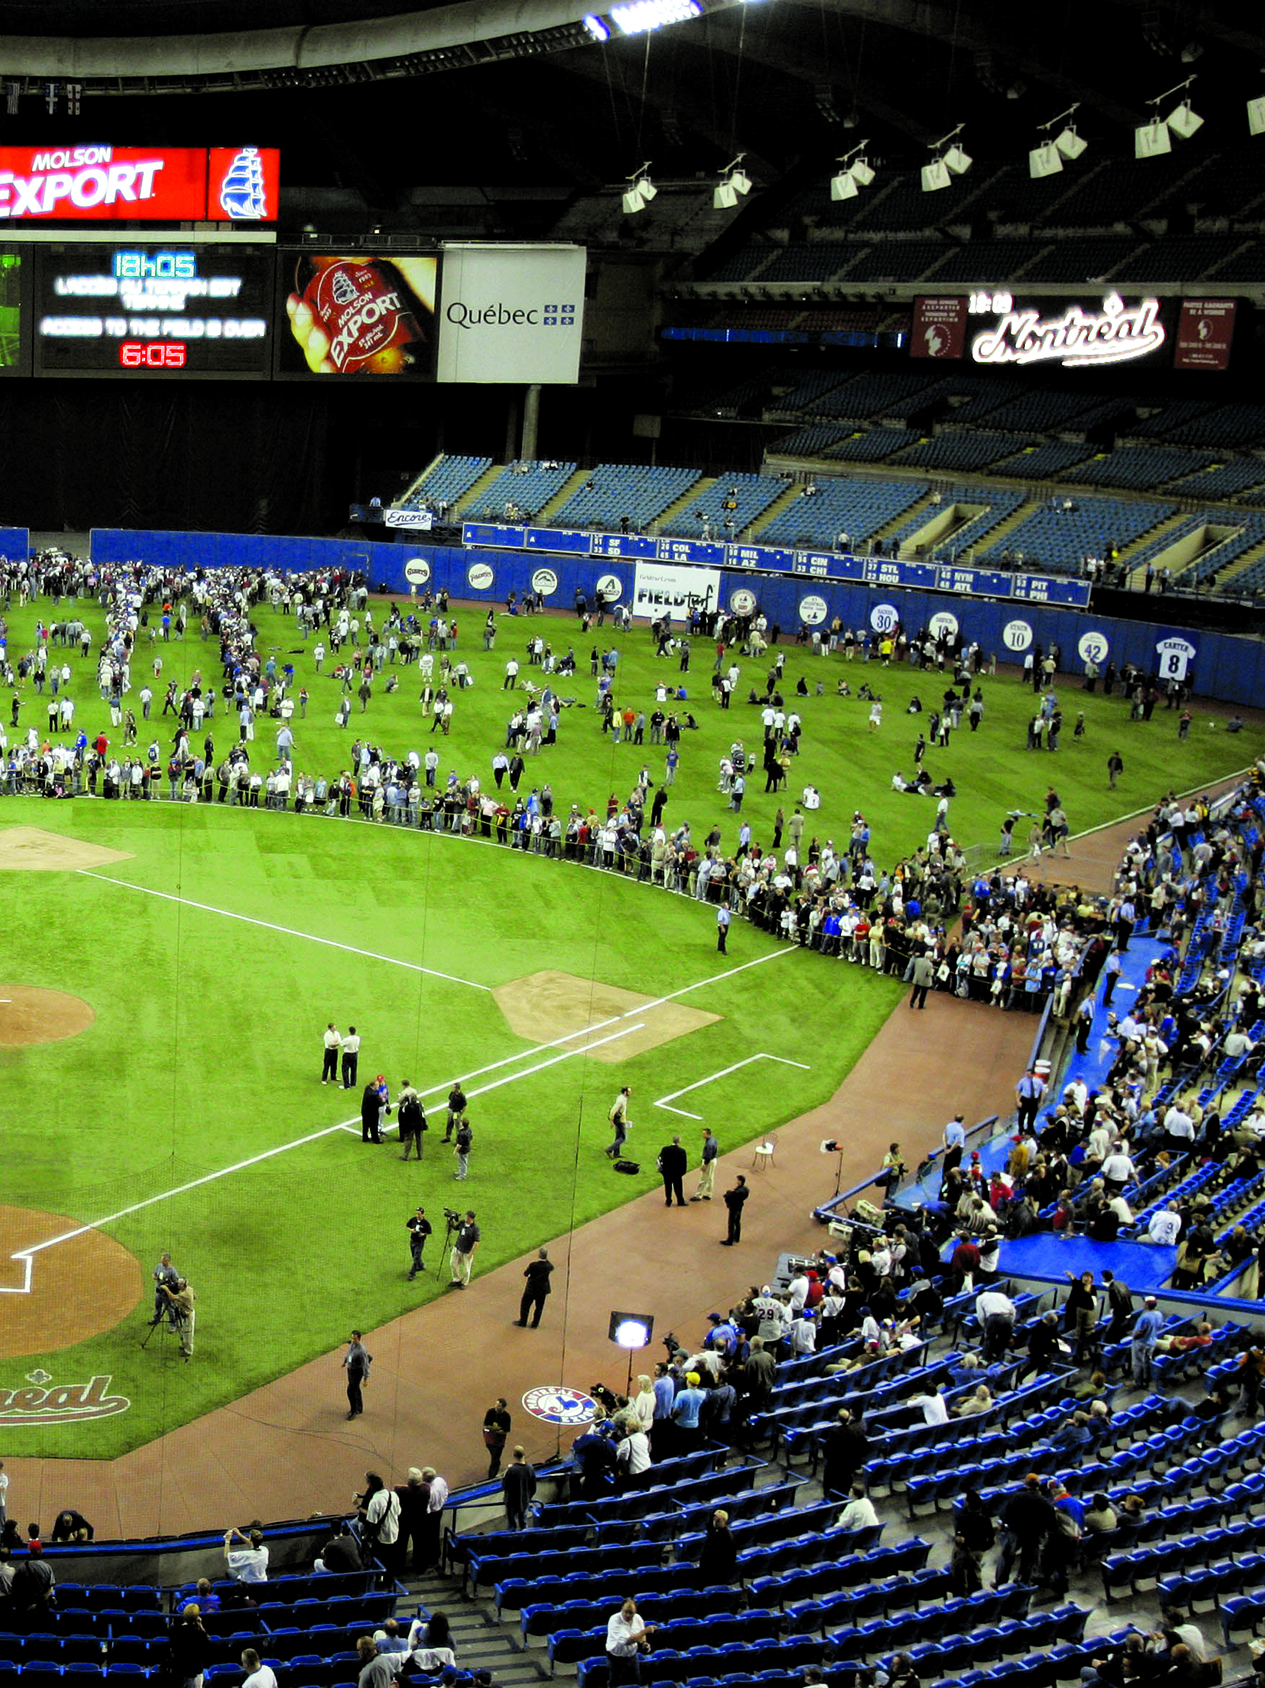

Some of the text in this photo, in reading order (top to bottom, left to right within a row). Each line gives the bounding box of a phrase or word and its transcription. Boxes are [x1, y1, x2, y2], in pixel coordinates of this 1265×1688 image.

[32, 147, 111, 171] MOLSON
[115, 254, 195, 277] 18h05
[337, 292, 373, 328] MOLSON
[447, 302, 538, 329] Québec
[105, 318, 127, 336] TO
[129, 318, 160, 336] THE
[161, 318, 204, 337] FIELD
[223, 318, 266, 338] OVER
[331, 293, 401, 368] EXPORT
[122, 344, 185, 366] 6:05
[387, 511, 430, 525] Encore
[609, 539, 621, 547] SF
[672, 544, 691, 553] COL
[674, 553, 688, 561] LA
[740, 550, 759, 559] MIL
[741, 559, 756, 567] AZ
[811, 557, 828, 566] CIN
[809, 567, 827, 575] CHI
[881, 564, 899, 574] STL
[879, 574, 899, 583] HOU
[954, 572, 973, 582] NYM
[953, 583, 972, 592] ATL
[1031, 580, 1048, 590] PIT
[1029, 591, 1048, 600] PHI
[877, 615, 891, 629] 30
[1011, 633, 1025, 647] 10
[1085, 644, 1101, 659] 42
[1164, 642, 1189, 652] CARTER
[1168, 655, 1180, 674] 8
[758, 1308, 774, 1320] 29
[526, 1387, 575, 1410] MONTREAL
